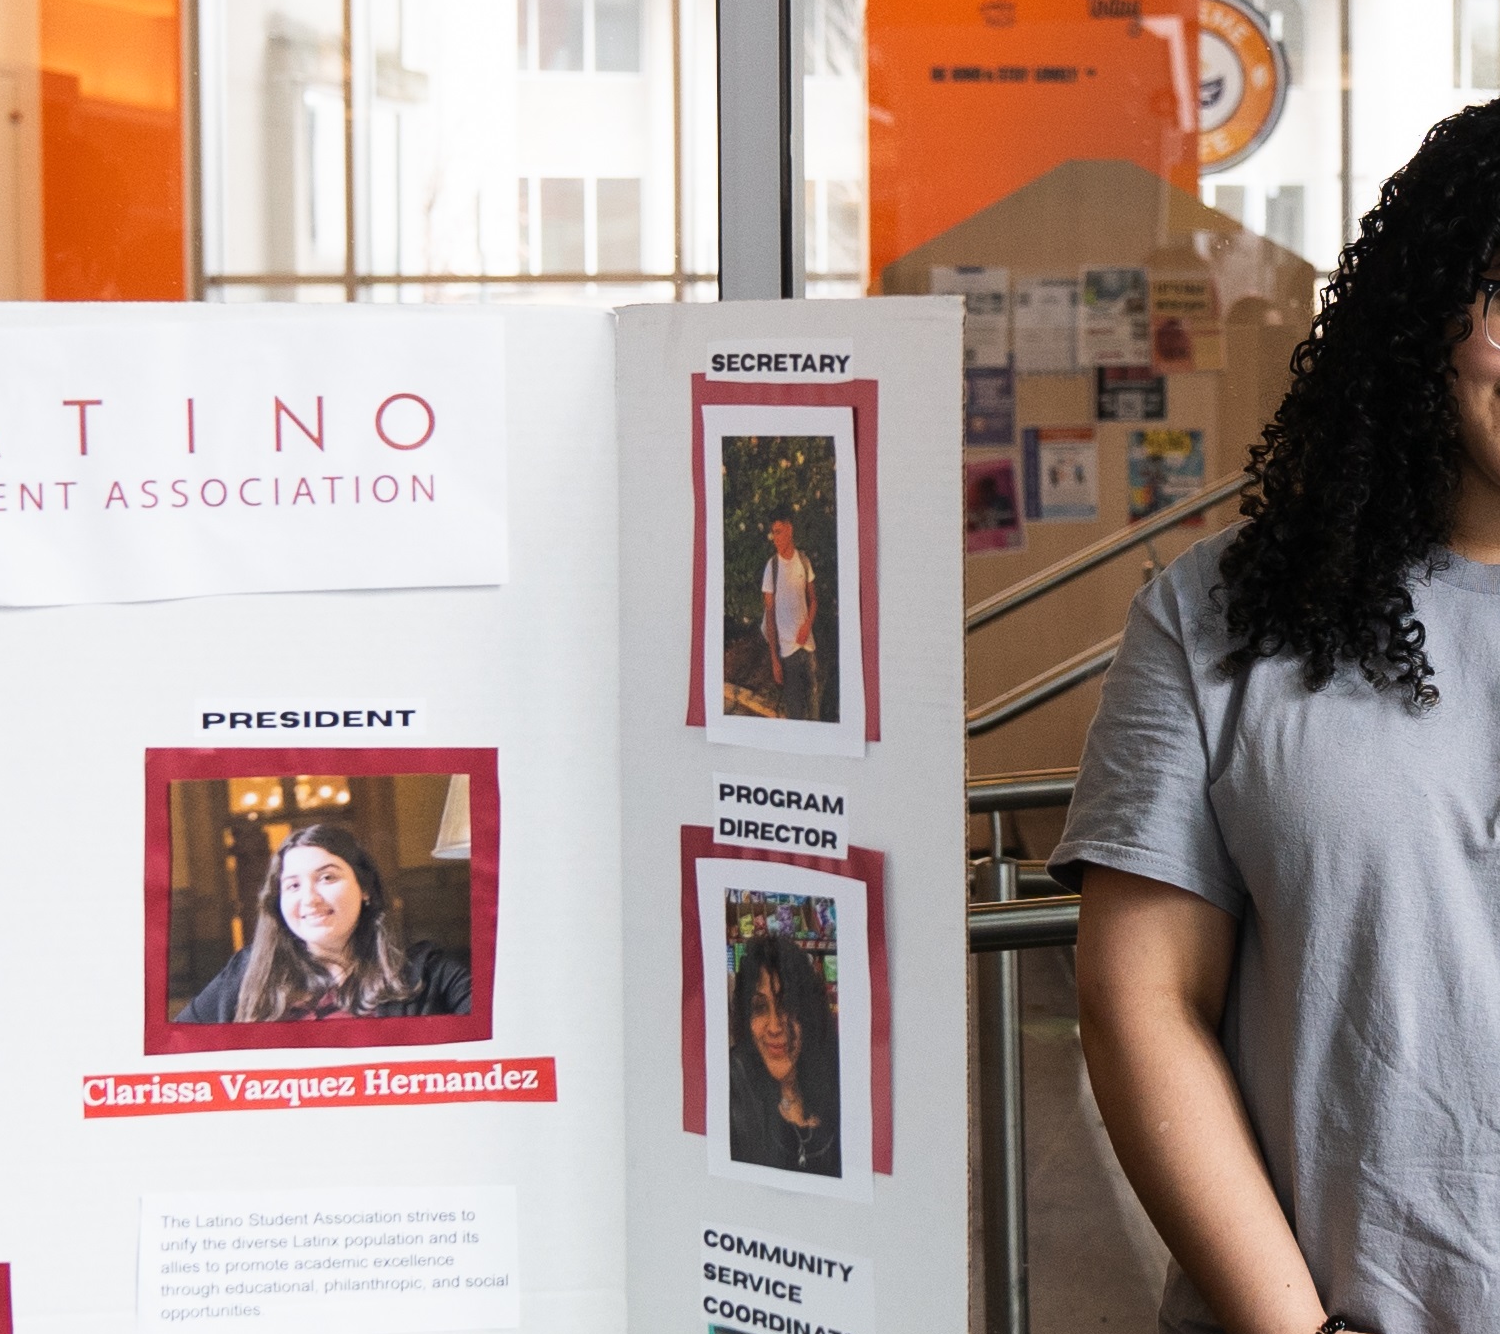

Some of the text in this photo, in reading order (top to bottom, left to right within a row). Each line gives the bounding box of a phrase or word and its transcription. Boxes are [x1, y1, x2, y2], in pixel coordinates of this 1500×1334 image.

[711, 353, 851, 373] SECRETARY
[105, 473, 438, 511] ASSOCIATION
[202, 709, 416, 730] PRESIDENT
[719, 783, 844, 815] PROGRAM
[719, 818, 838, 850] DIRECTOR
[83, 1064, 539, 1106] Clarissa Vazquez Hernandez
[161, 1210, 476, 1228] The Latino Student Association strives to
[161, 1231, 479, 1254] unify the diverse Latinx population and its
[703, 1228, 853, 1283] COMMUNITY
[161, 1254, 455, 1275] allies to promote academic excellence
[161, 1273, 509, 1299] through educational, philanthropic, and social
[703, 1263, 802, 1304] SERVICE
[160, 1305, 264, 1322] opportunities.
